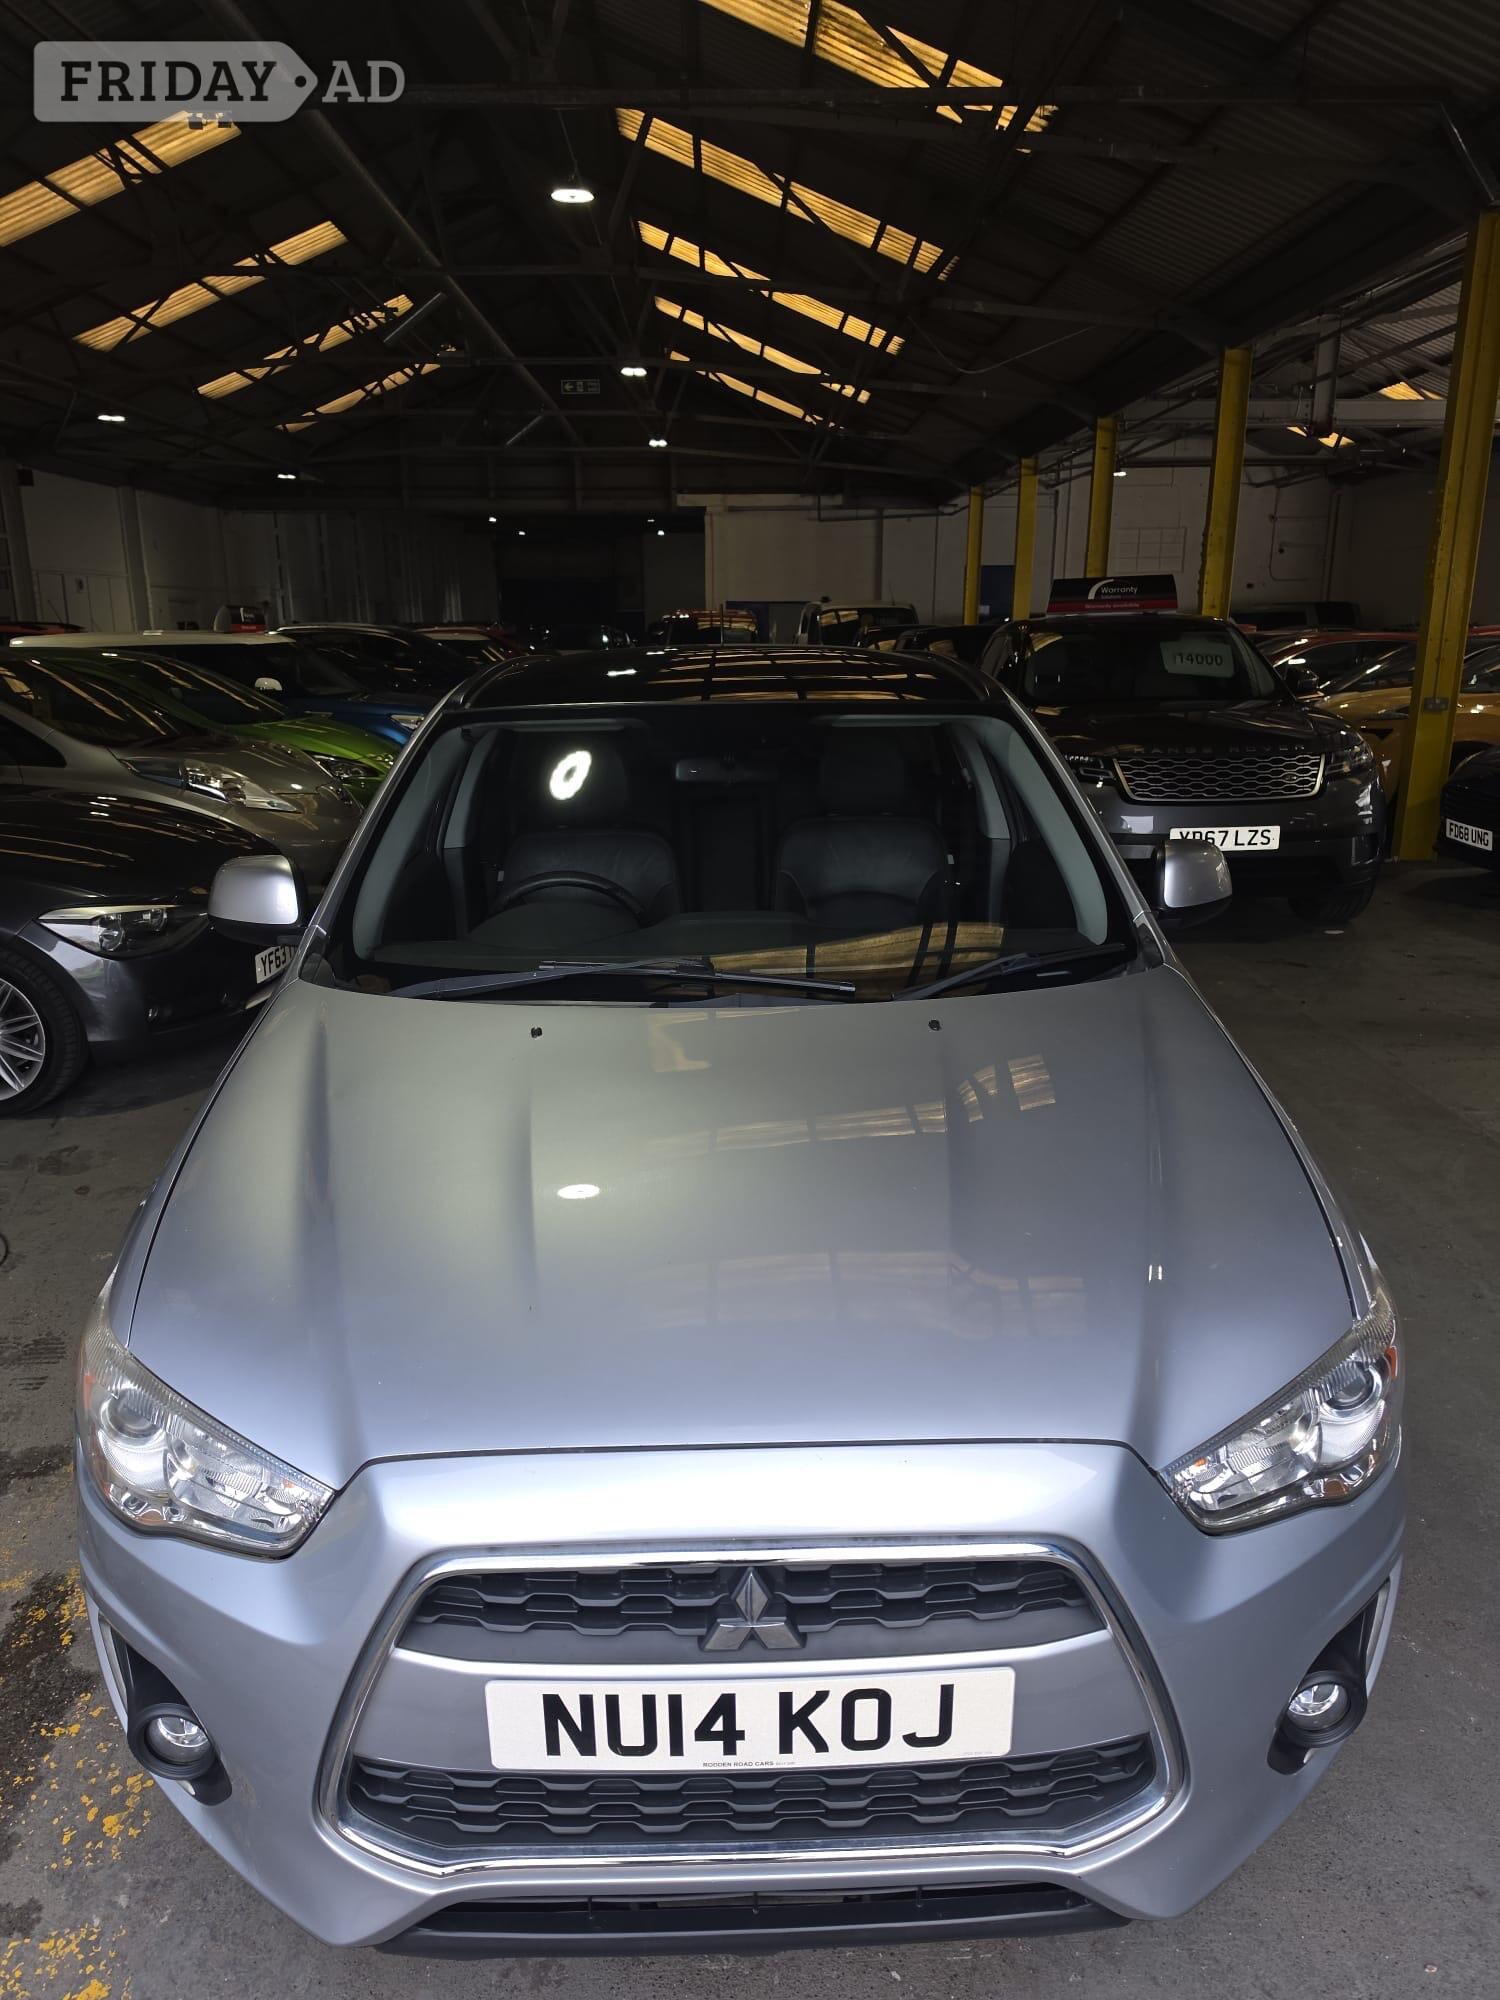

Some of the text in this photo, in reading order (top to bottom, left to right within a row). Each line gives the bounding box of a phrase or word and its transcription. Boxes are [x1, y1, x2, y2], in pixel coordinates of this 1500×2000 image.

[1101, 586, 1138, 595] Warranty
[1235, 829, 1271, 846] LZS
[1449, 822, 1488, 847] FD68 UNG
[260, 945, 286, 977] YF63
[542, 1684, 956, 1757] NU14 KOJ
